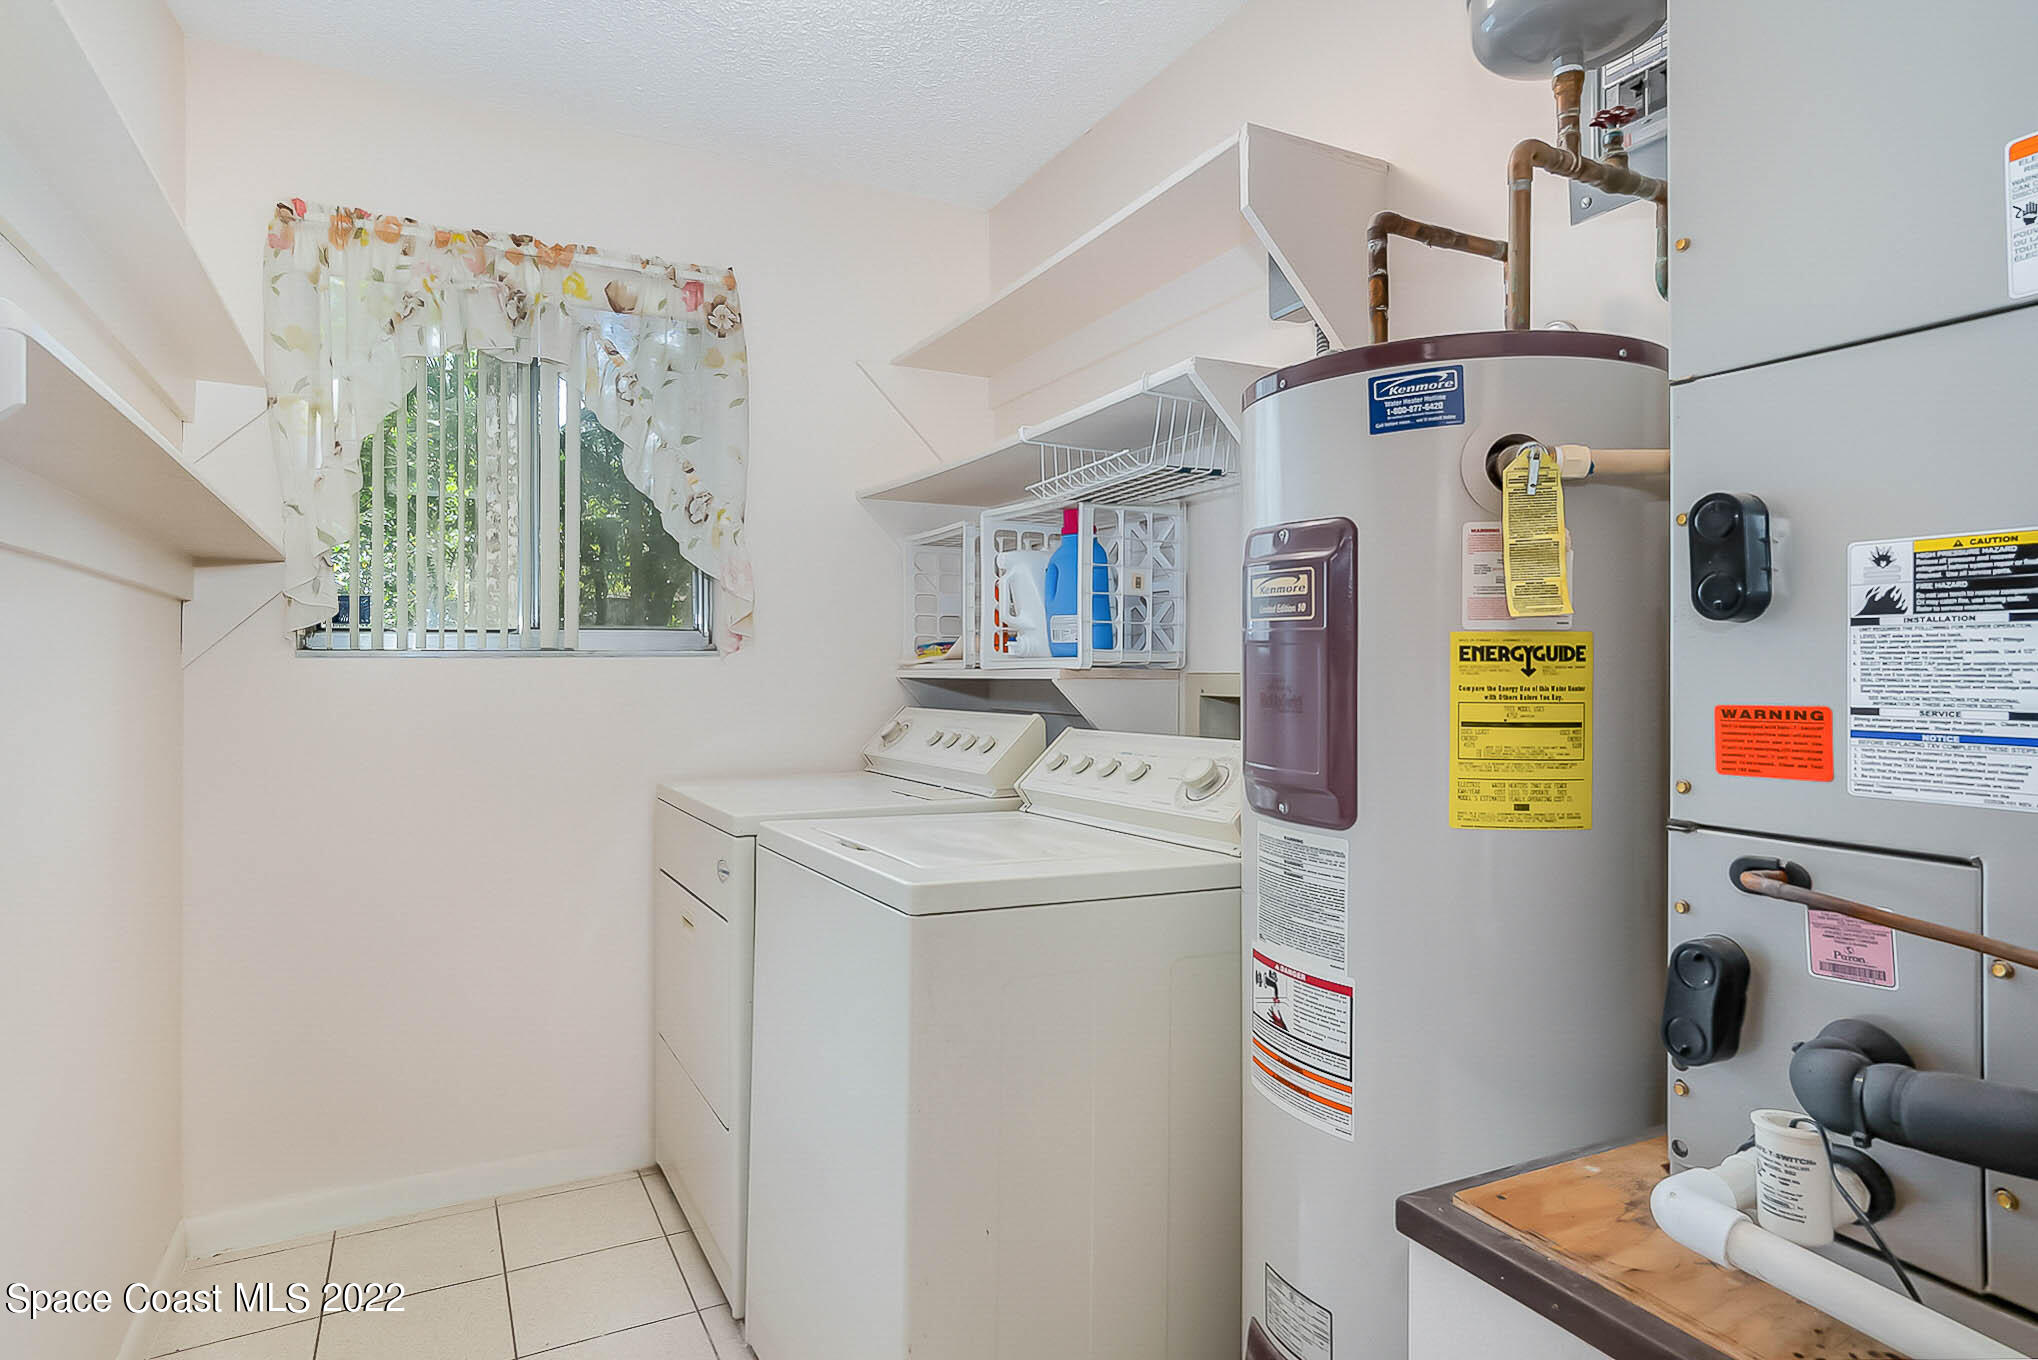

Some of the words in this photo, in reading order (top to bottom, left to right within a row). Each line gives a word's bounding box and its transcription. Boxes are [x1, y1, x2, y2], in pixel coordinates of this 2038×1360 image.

[1388, 380, 1454, 396] Kenmore
[1969, 535, 2019, 545] CAUTION
[1981, 545, 2018, 553] HAZARD
[1259, 583, 1306, 594] Kenmore
[1904, 615, 1976, 623] INSTALLATION
[1459, 644, 1586, 664] ENERGYGUIDE
[1498, 685, 1519, 693] Energy
[1721, 708, 1824, 721] WARNING
[1919, 710, 1961, 718] SERVICE
[1922, 735, 1960, 743] NOTICE
